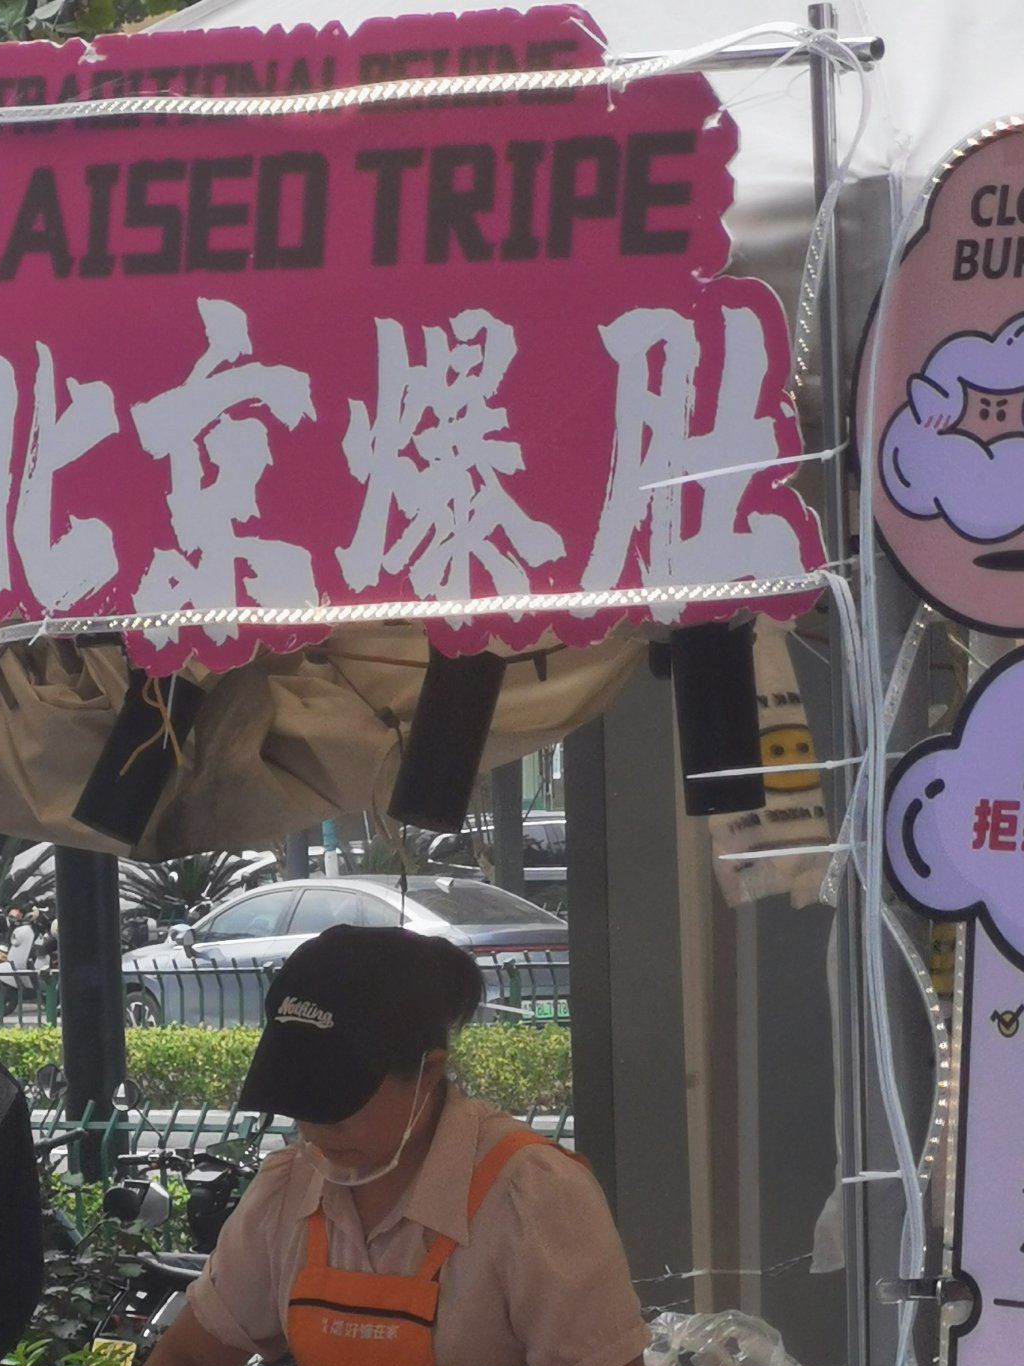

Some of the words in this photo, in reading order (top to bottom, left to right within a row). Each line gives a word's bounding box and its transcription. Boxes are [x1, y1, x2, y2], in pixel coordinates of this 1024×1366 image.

[355, 131, 697, 266] TRIPE
[971, 184, 1024, 228] CL
[972, 798, 1024, 851] 拒
